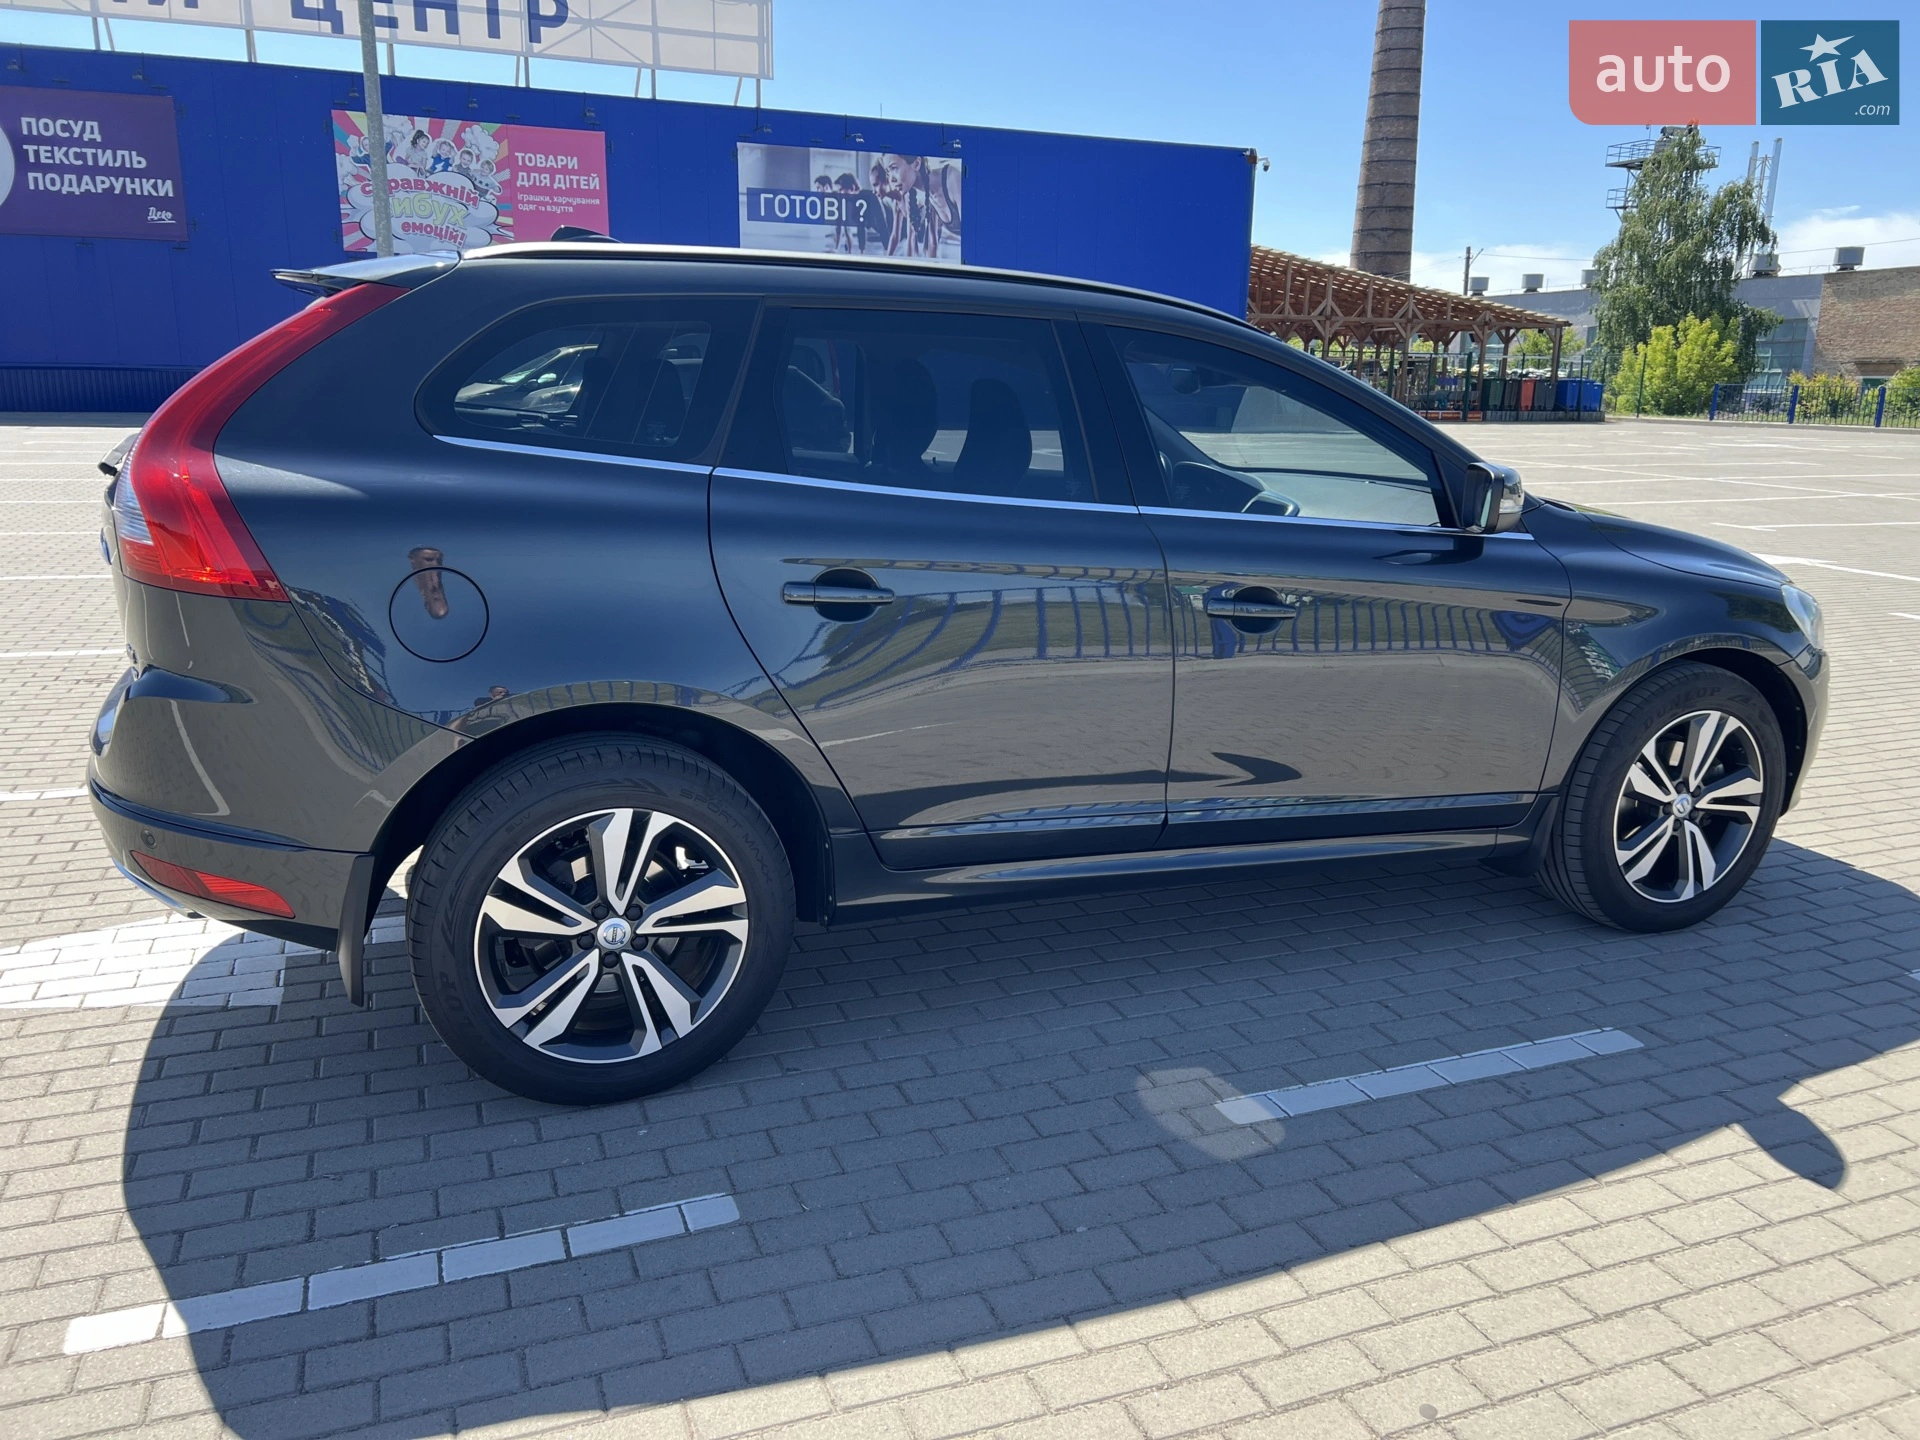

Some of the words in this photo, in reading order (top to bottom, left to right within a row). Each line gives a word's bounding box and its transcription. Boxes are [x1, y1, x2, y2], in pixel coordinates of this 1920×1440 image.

[291, 0, 569, 44] ЦНР
[20, 116, 102, 142] ПОСУД
[22, 144, 147, 170] ТЕКСТИЛЬ
[514, 151, 579, 170] ТОВАРИ
[27, 171, 174, 197] ПОДАРУНКИ
[360, 178, 480, 208] сравжній
[516, 171, 551, 188] ДЛЯ
[553, 173, 600, 190] ДІТЕЙ
[388, 193, 469, 230] ибух
[518, 202, 537, 212] одяг
[546, 205, 574, 214] взуття
[553, 195, 600, 206] харчування
[760, 193, 847, 222] ГОТОВІ
[401, 220, 466, 249] емоцій!
[679, 787, 743, 829] SPORT
